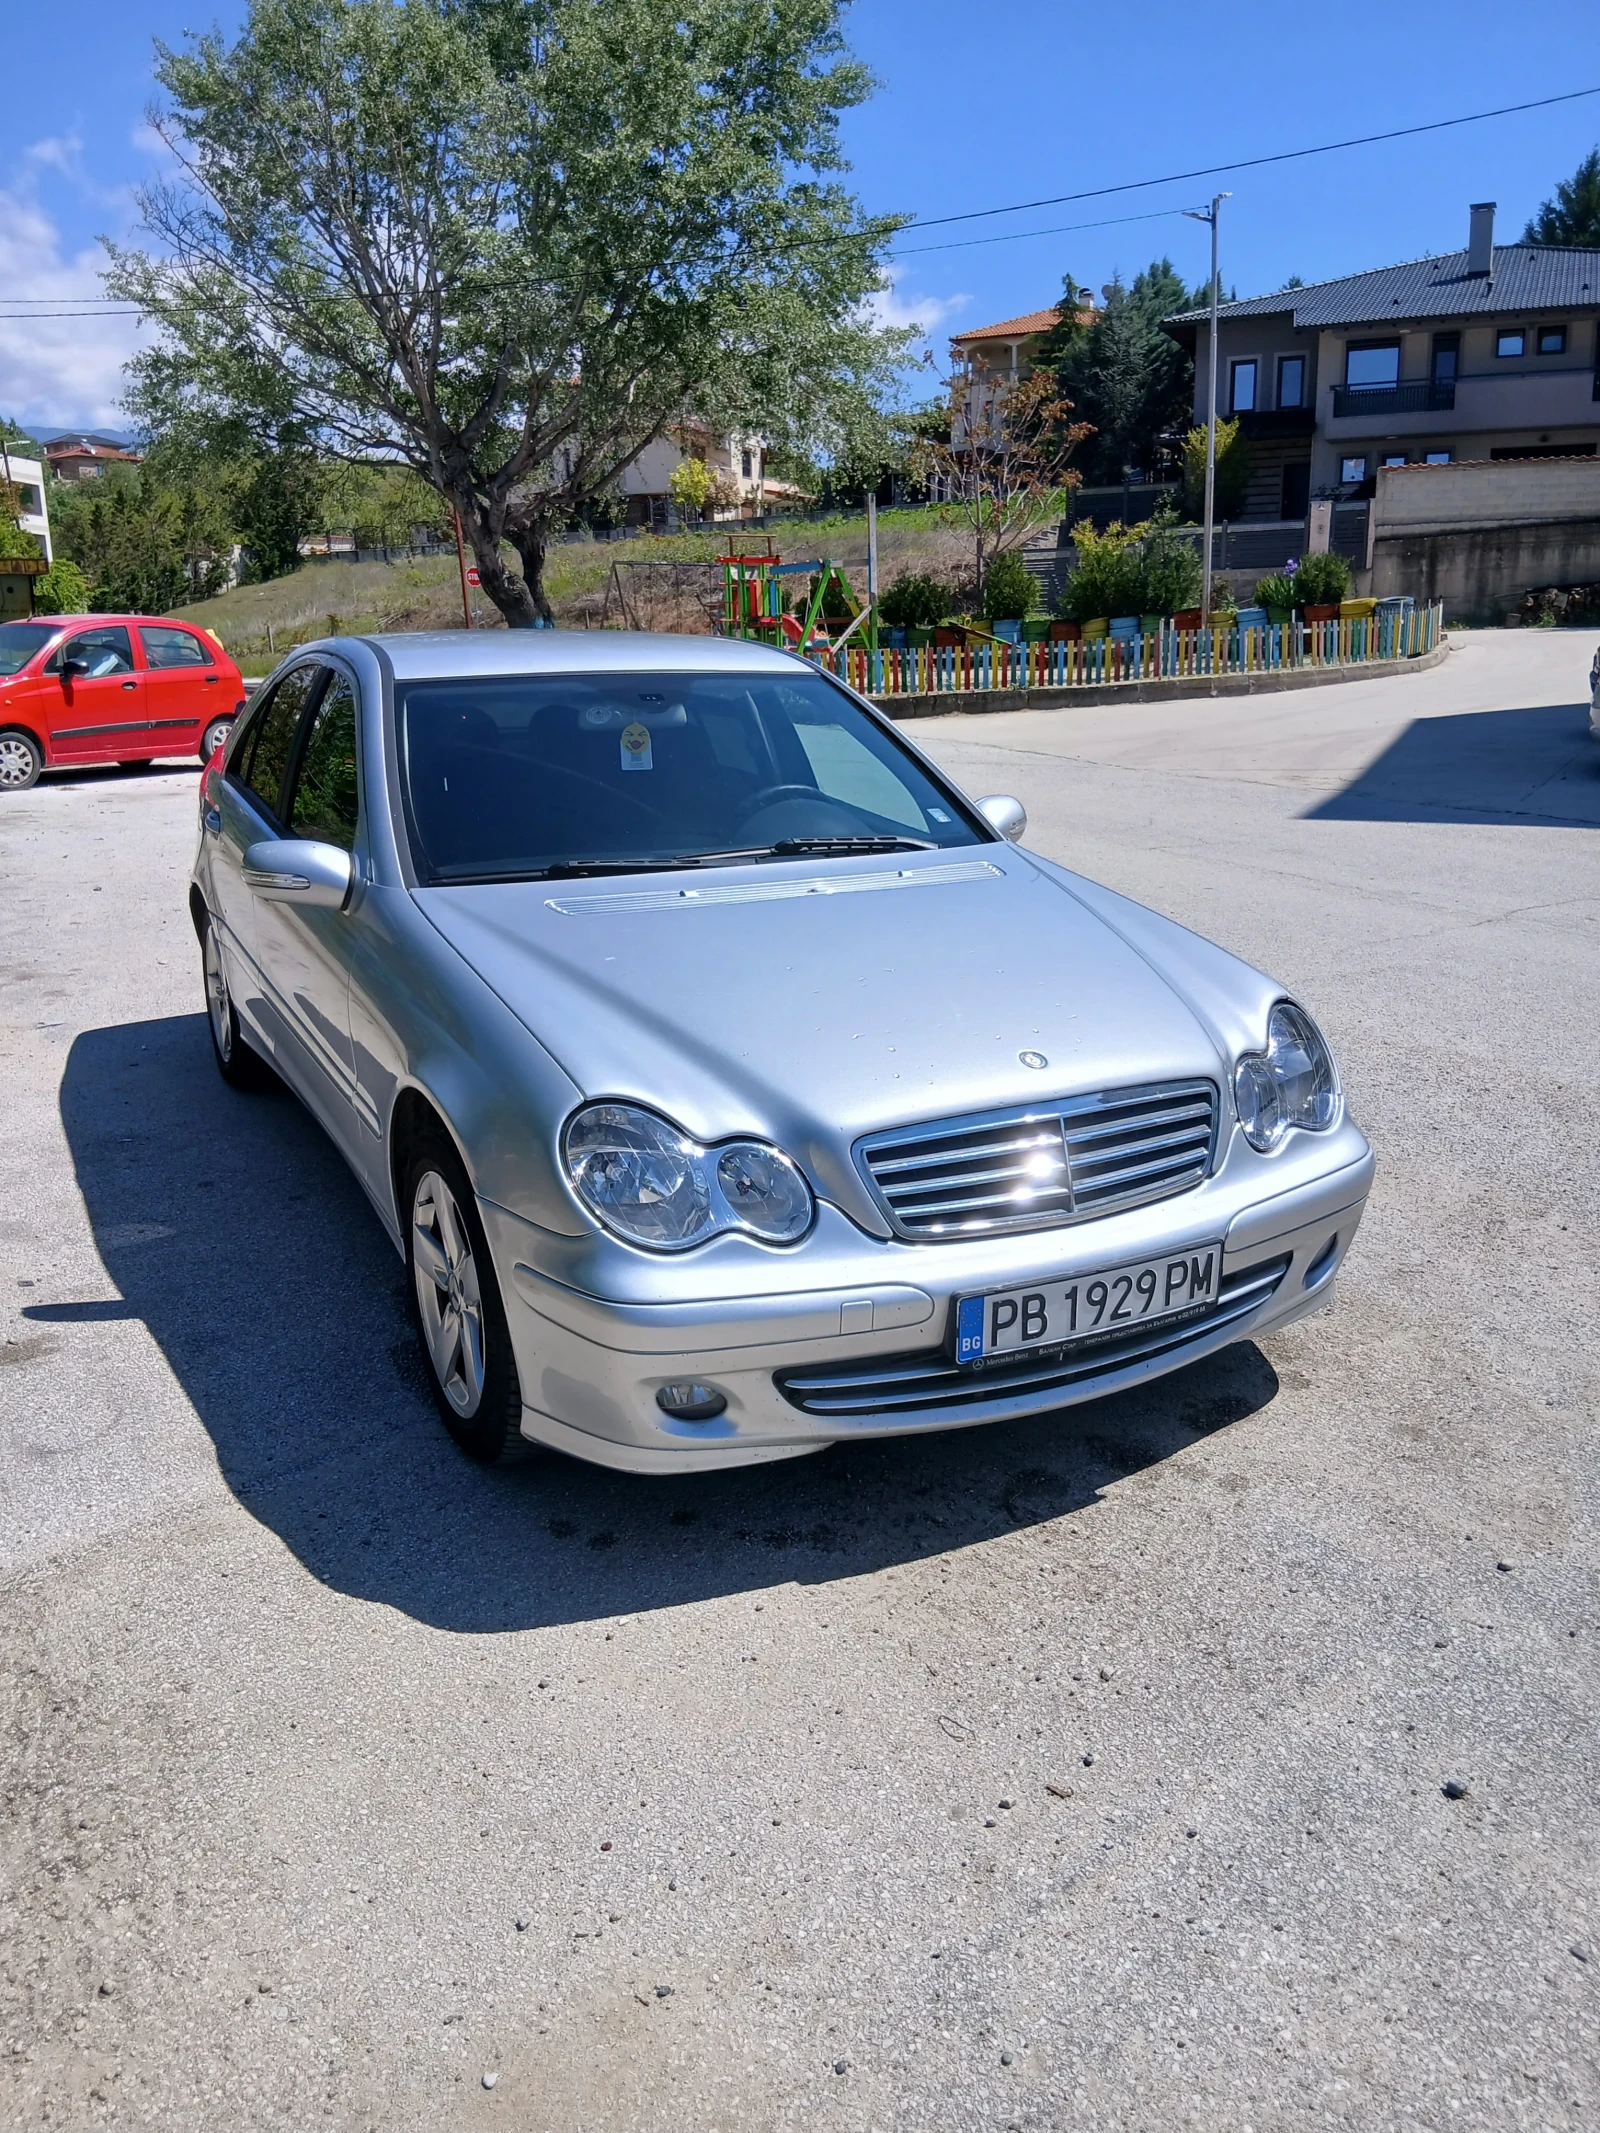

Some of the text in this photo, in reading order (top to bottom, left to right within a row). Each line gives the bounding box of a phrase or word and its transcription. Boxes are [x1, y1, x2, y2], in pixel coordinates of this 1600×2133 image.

[467, 573, 480, 581] STO
[991, 1251, 1214, 1347] PB 1929 PM
[962, 1335, 981, 1352] BG
[986, 1352, 1029, 1366] Mercedes-Benz
